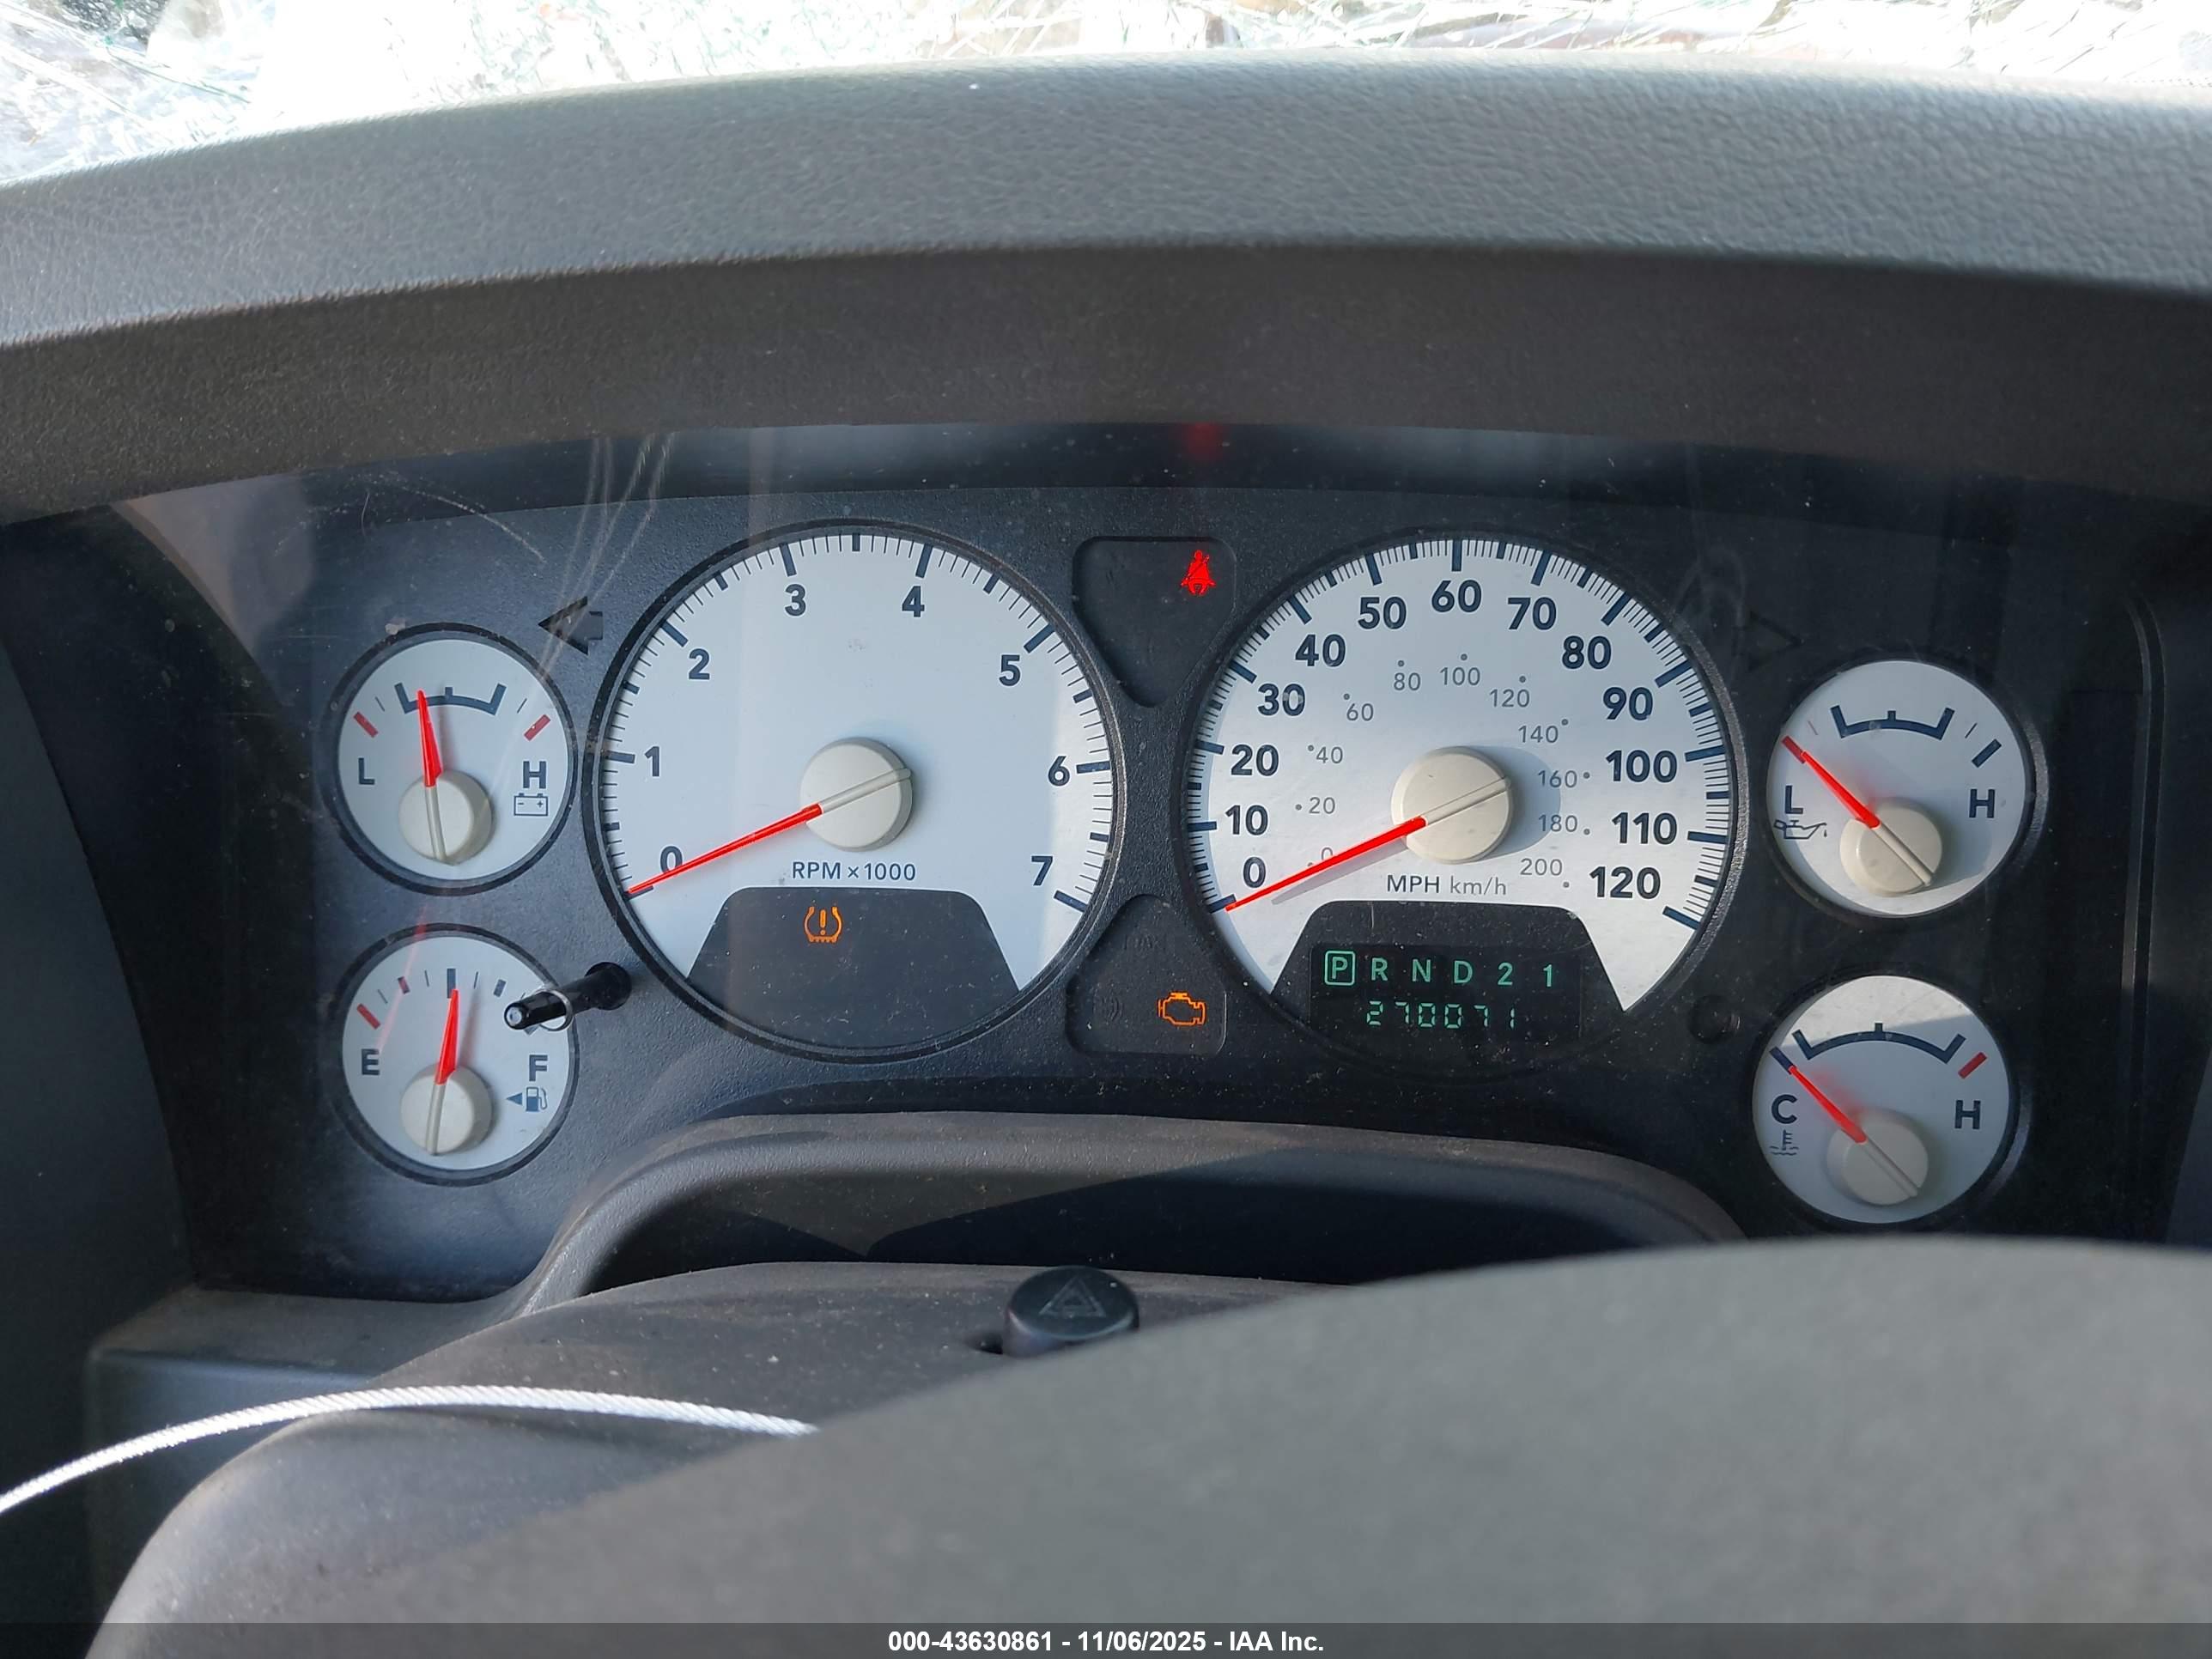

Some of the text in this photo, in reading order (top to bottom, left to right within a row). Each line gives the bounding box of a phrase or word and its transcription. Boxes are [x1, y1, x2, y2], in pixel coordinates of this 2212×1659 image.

[785, 584, 805, 616] 3
[902, 586, 924, 617] 4
[1432, 580, 1481, 612] 60
[1358, 597, 1406, 629] 50
[1508, 598, 1556, 629] 70
[689, 648, 709, 679] 2
[1296, 635, 1346, 666] 40
[1562, 636, 1611, 669] 80
[1000, 655, 1020, 686] 5
[1394, 673, 1420, 690] 80
[1441, 667, 1480, 685] 100
[1258, 684, 1305, 716] 30
[1346, 703, 1373, 721] 60
[1490, 690, 1529, 707] 120
[1603, 687, 1653, 720] 90
[1519, 726, 1558, 743] 140
[645, 746, 659, 776] 1
[1231, 744, 1279, 776] 20
[1316, 746, 1343, 764] 40
[1606, 750, 1677, 782] 100
[358, 758, 374, 785] L
[523, 761, 546, 788] H
[1048, 756, 1070, 786] 6
[1538, 769, 1578, 788] 160
[1310, 797, 1335, 814] 20
[1784, 786, 1803, 814] L
[1969, 789, 1995, 818] H
[1225, 805, 1267, 836] 10
[1539, 814, 1578, 833] 180
[1612, 812, 1677, 844] 110
[660, 846, 683, 873] 0
[793, 861, 841, 880] RPM
[1031, 856, 1053, 885] 7
[1243, 858, 1266, 889] 0
[1521, 858, 1562, 876] 200
[1388, 875, 1505, 895] MPH km/h
[1589, 866, 1660, 899] 120
[1330, 958, 1553, 986] P R N D 2 1
[1367, 1000, 1516, 1029] 270071
[362, 1049, 380, 1075] E
[529, 1054, 547, 1081] F
[1771, 1095, 1797, 1124] C
[1955, 1100, 1980, 1129] H
